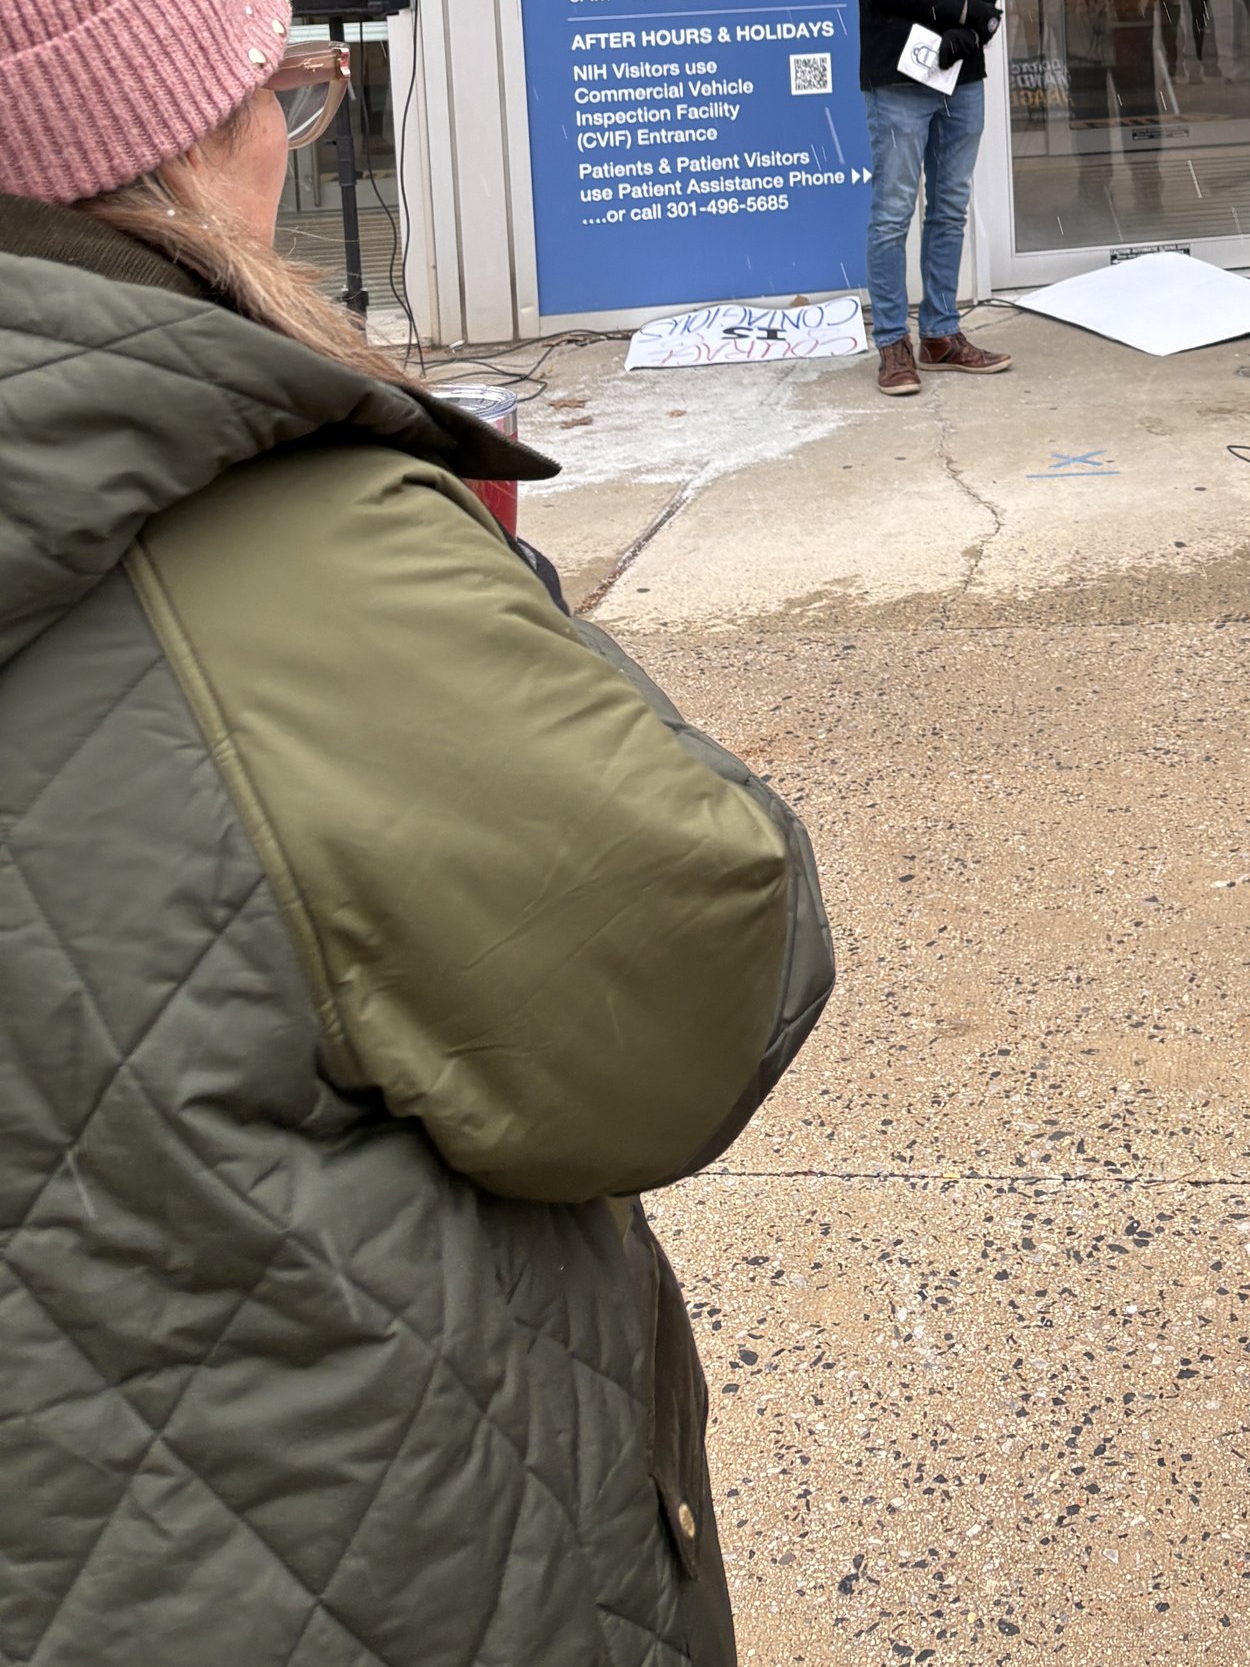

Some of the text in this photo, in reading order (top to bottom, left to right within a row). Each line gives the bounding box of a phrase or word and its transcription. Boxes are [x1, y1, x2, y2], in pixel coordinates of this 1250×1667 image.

[572, 21, 834, 50] AFTER HOURS & HOLIDAYS
[574, 62, 717, 81] NIH Visitors use
[575, 79, 753, 103] Commercial Vehicle
[576, 102, 739, 128] Inspection Facility
[578, 128, 717, 152] (CVIF) Entrance
[580, 151, 809, 179] Patients & Patient Visitors
[581, 171, 844, 202] use Patient Assistance Phone
[583, 195, 788, 224] ....or call 301-496-5685
[636, 298, 858, 343] CONTAGIOUS
[722, 327, 787, 341] IS
[648, 337, 857, 366] COURAGE
